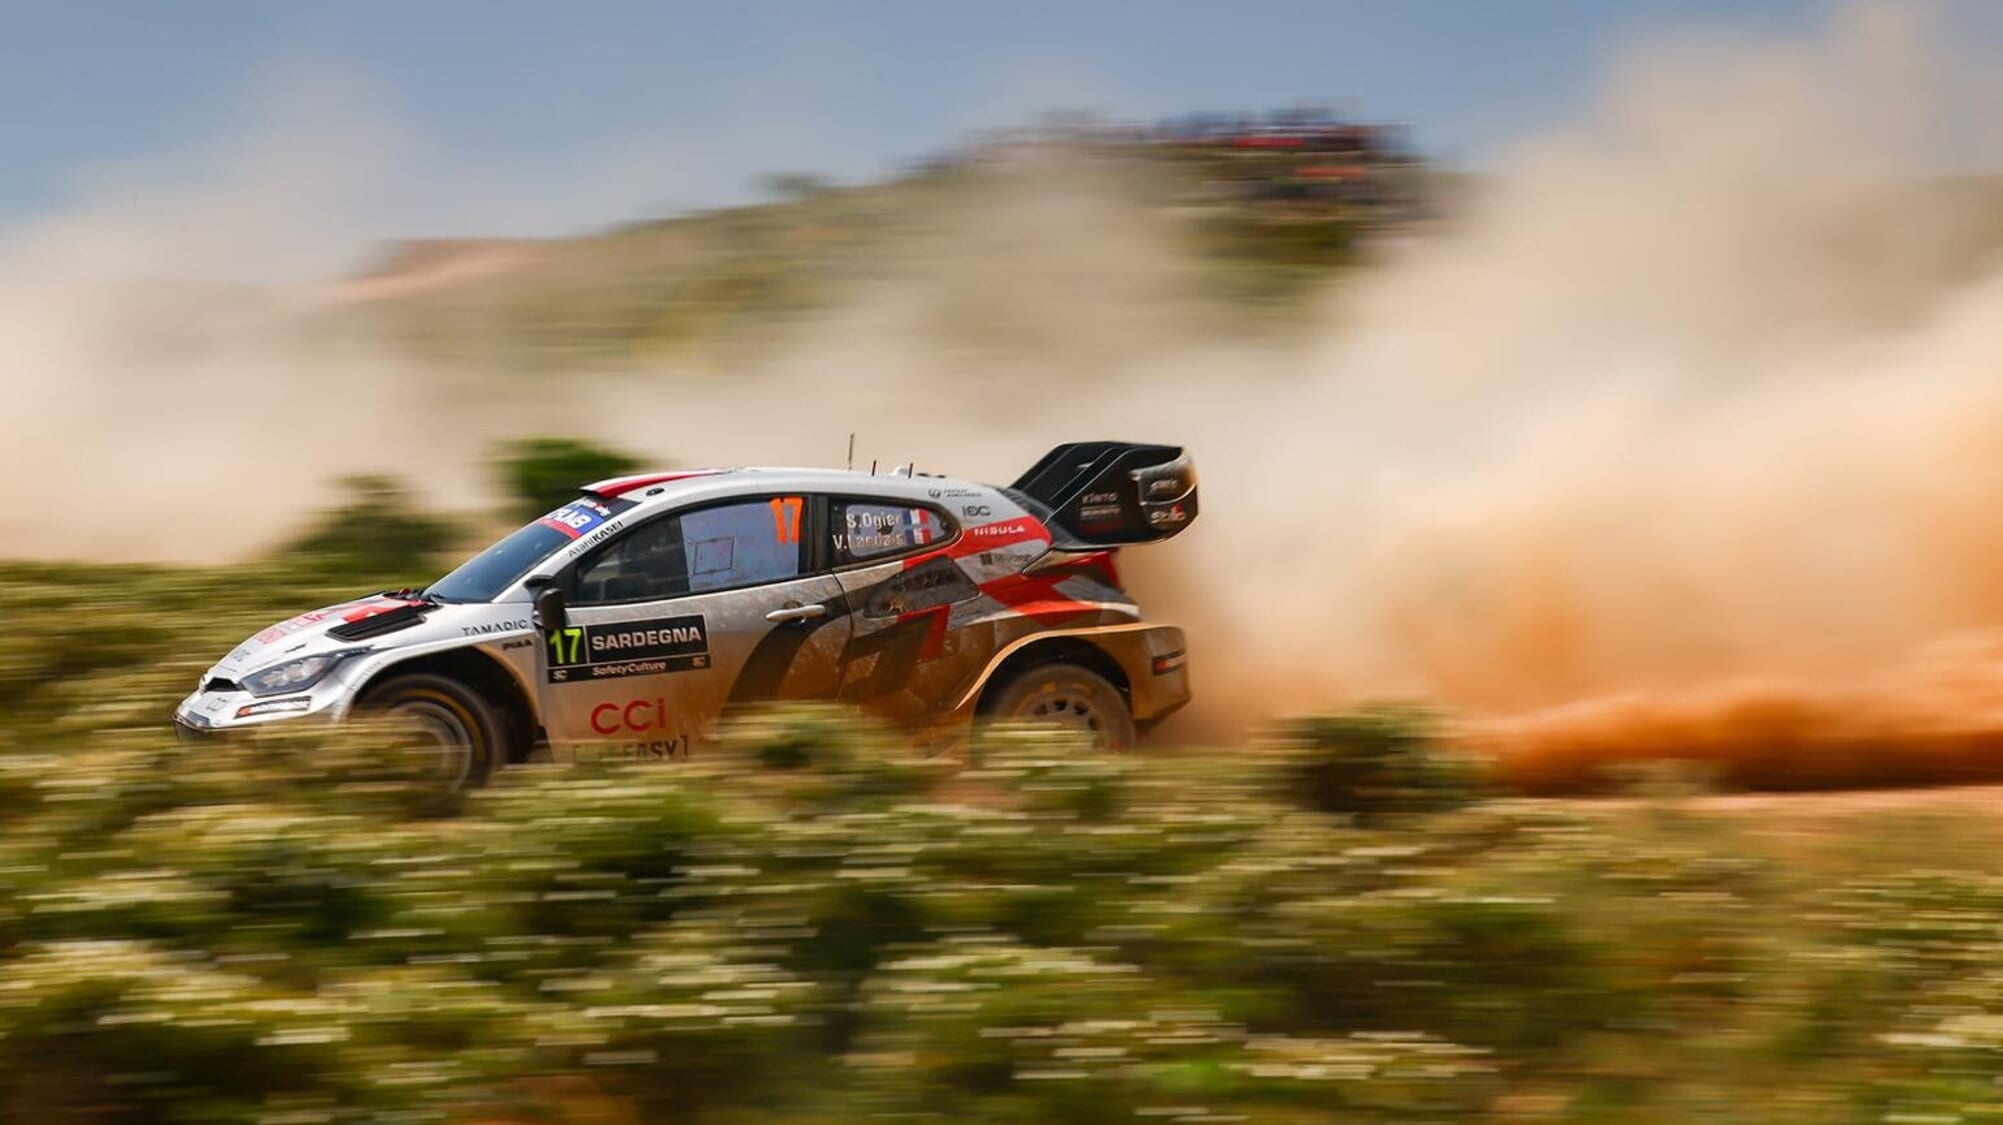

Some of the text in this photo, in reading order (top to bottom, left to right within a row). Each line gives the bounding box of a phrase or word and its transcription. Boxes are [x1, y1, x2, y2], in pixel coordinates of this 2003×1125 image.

[770, 496, 803, 543] 17
[462, 619, 528, 636] TAMADIC
[550, 626, 702, 664] 17 SARDEGNA
[592, 661, 667, 677] SafetyCulture
